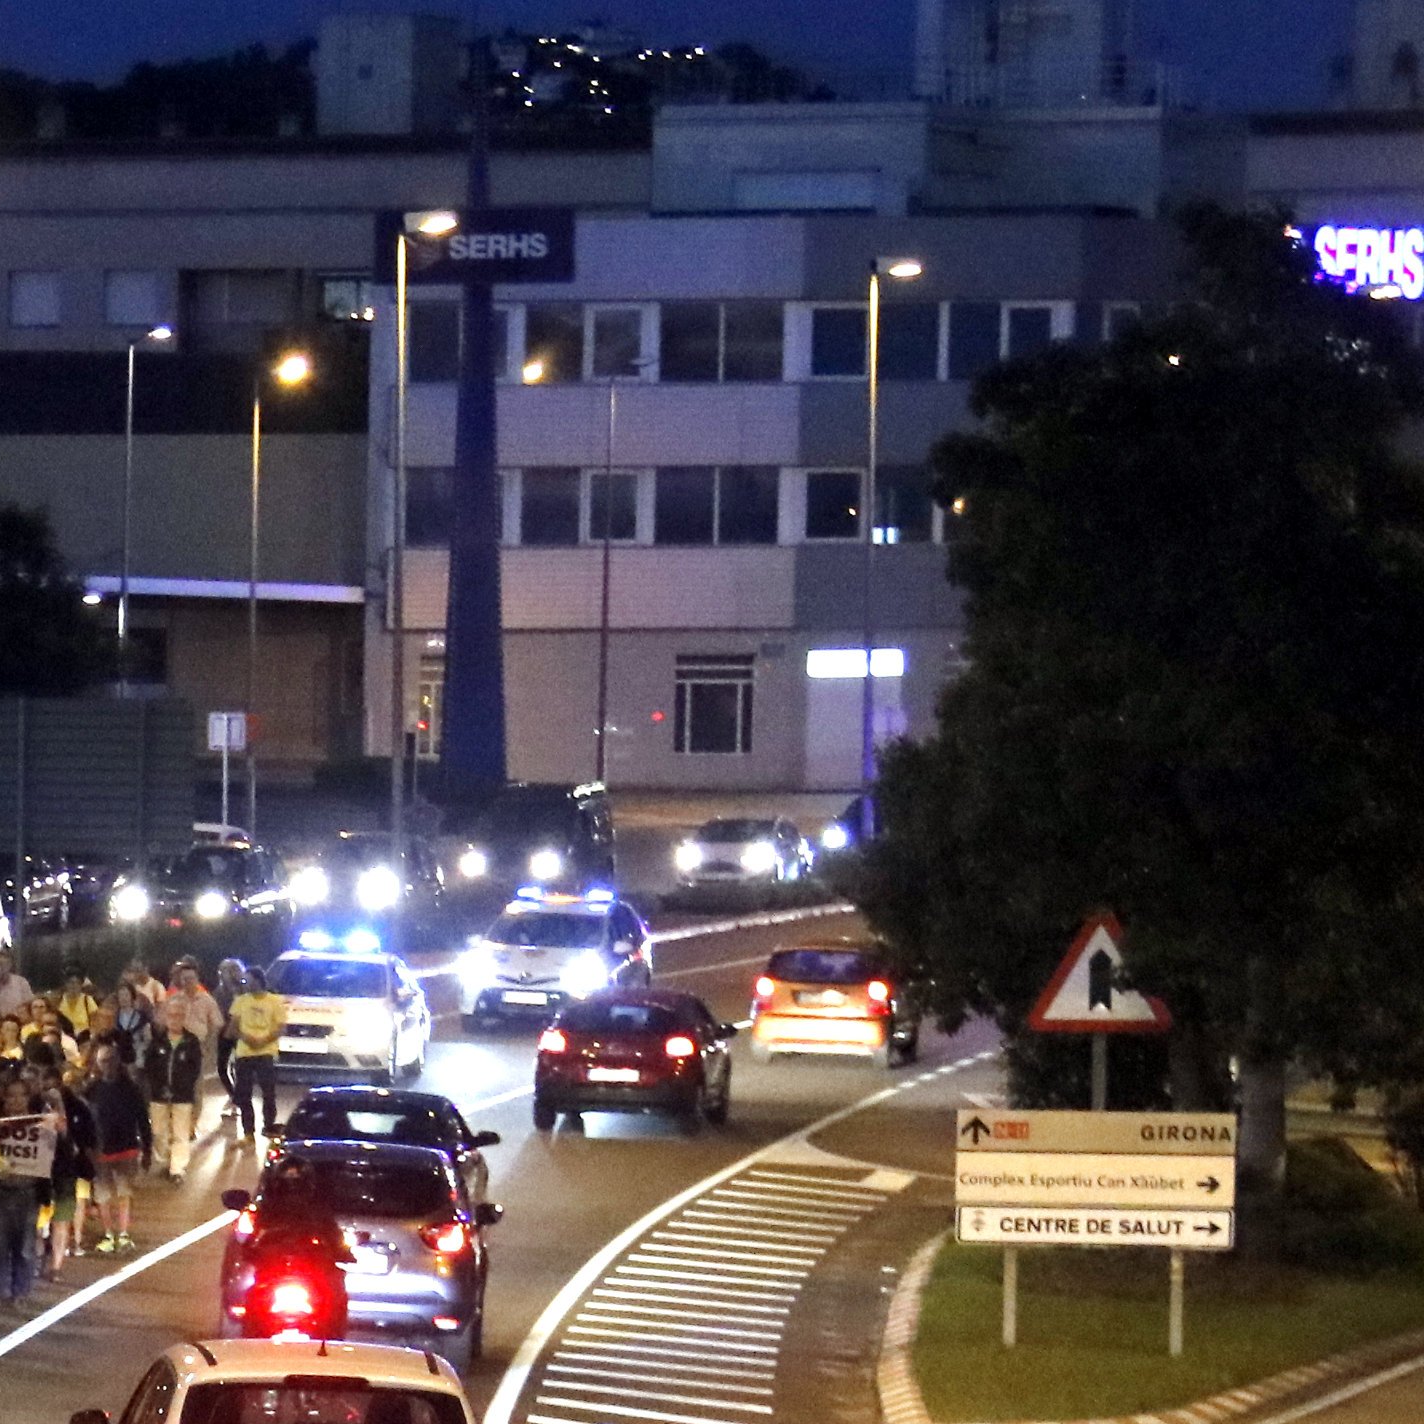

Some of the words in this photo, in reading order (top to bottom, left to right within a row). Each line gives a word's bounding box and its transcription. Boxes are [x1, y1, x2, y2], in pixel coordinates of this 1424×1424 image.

[450, 232, 547, 259] SERHS
[1140, 1124, 1232, 1142] GIRONA
[959, 1173, 1025, 1188] Complex
[1030, 1174, 1092, 1190] Esportiu
[1096, 1175, 1125, 1189] Can
[999, 1216, 1079, 1234] CENTRE
[1086, 1218, 1113, 1235] DE
[1118, 1218, 1185, 1236] SALUT
